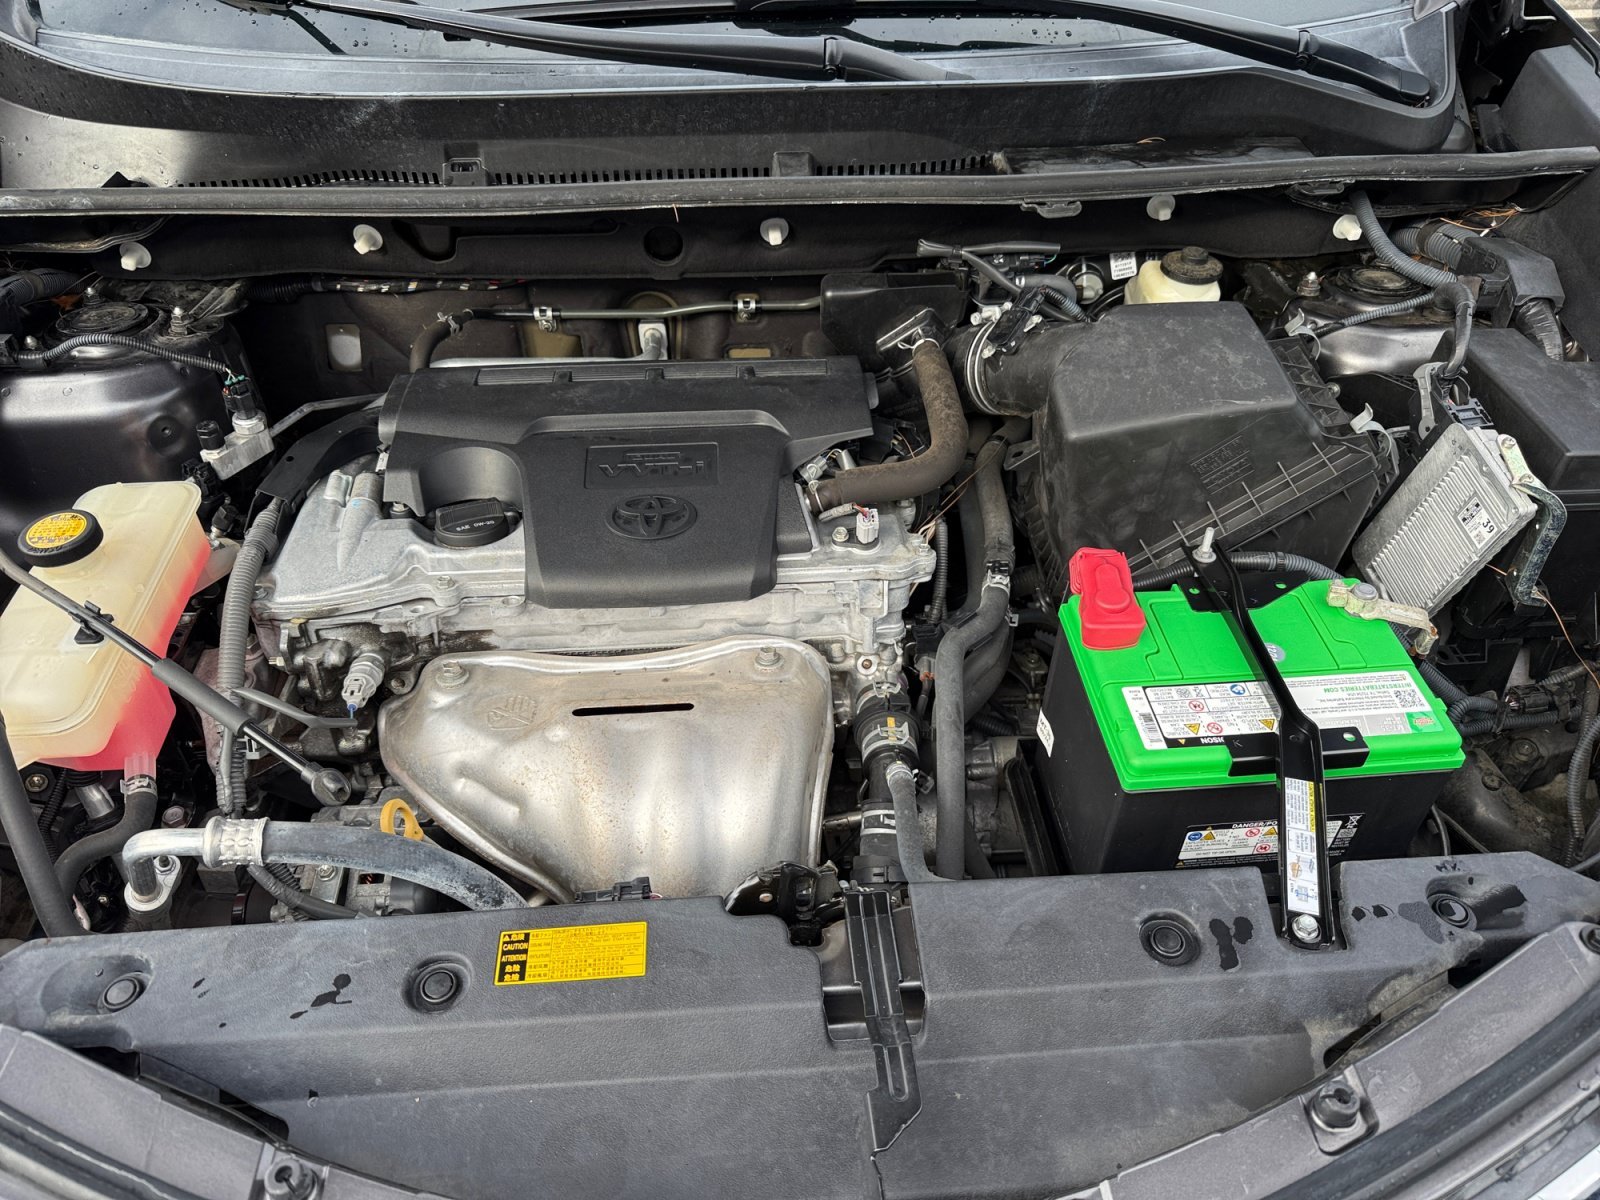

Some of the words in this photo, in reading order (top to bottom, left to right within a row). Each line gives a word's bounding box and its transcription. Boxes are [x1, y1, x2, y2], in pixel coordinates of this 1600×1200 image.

[1482, 517, 1495, 534] 39
[1231, 820, 1278, 829] DANGER/PO
[503, 943, 528, 951] CAUTION
[501, 953, 527, 962] ATTENTION
